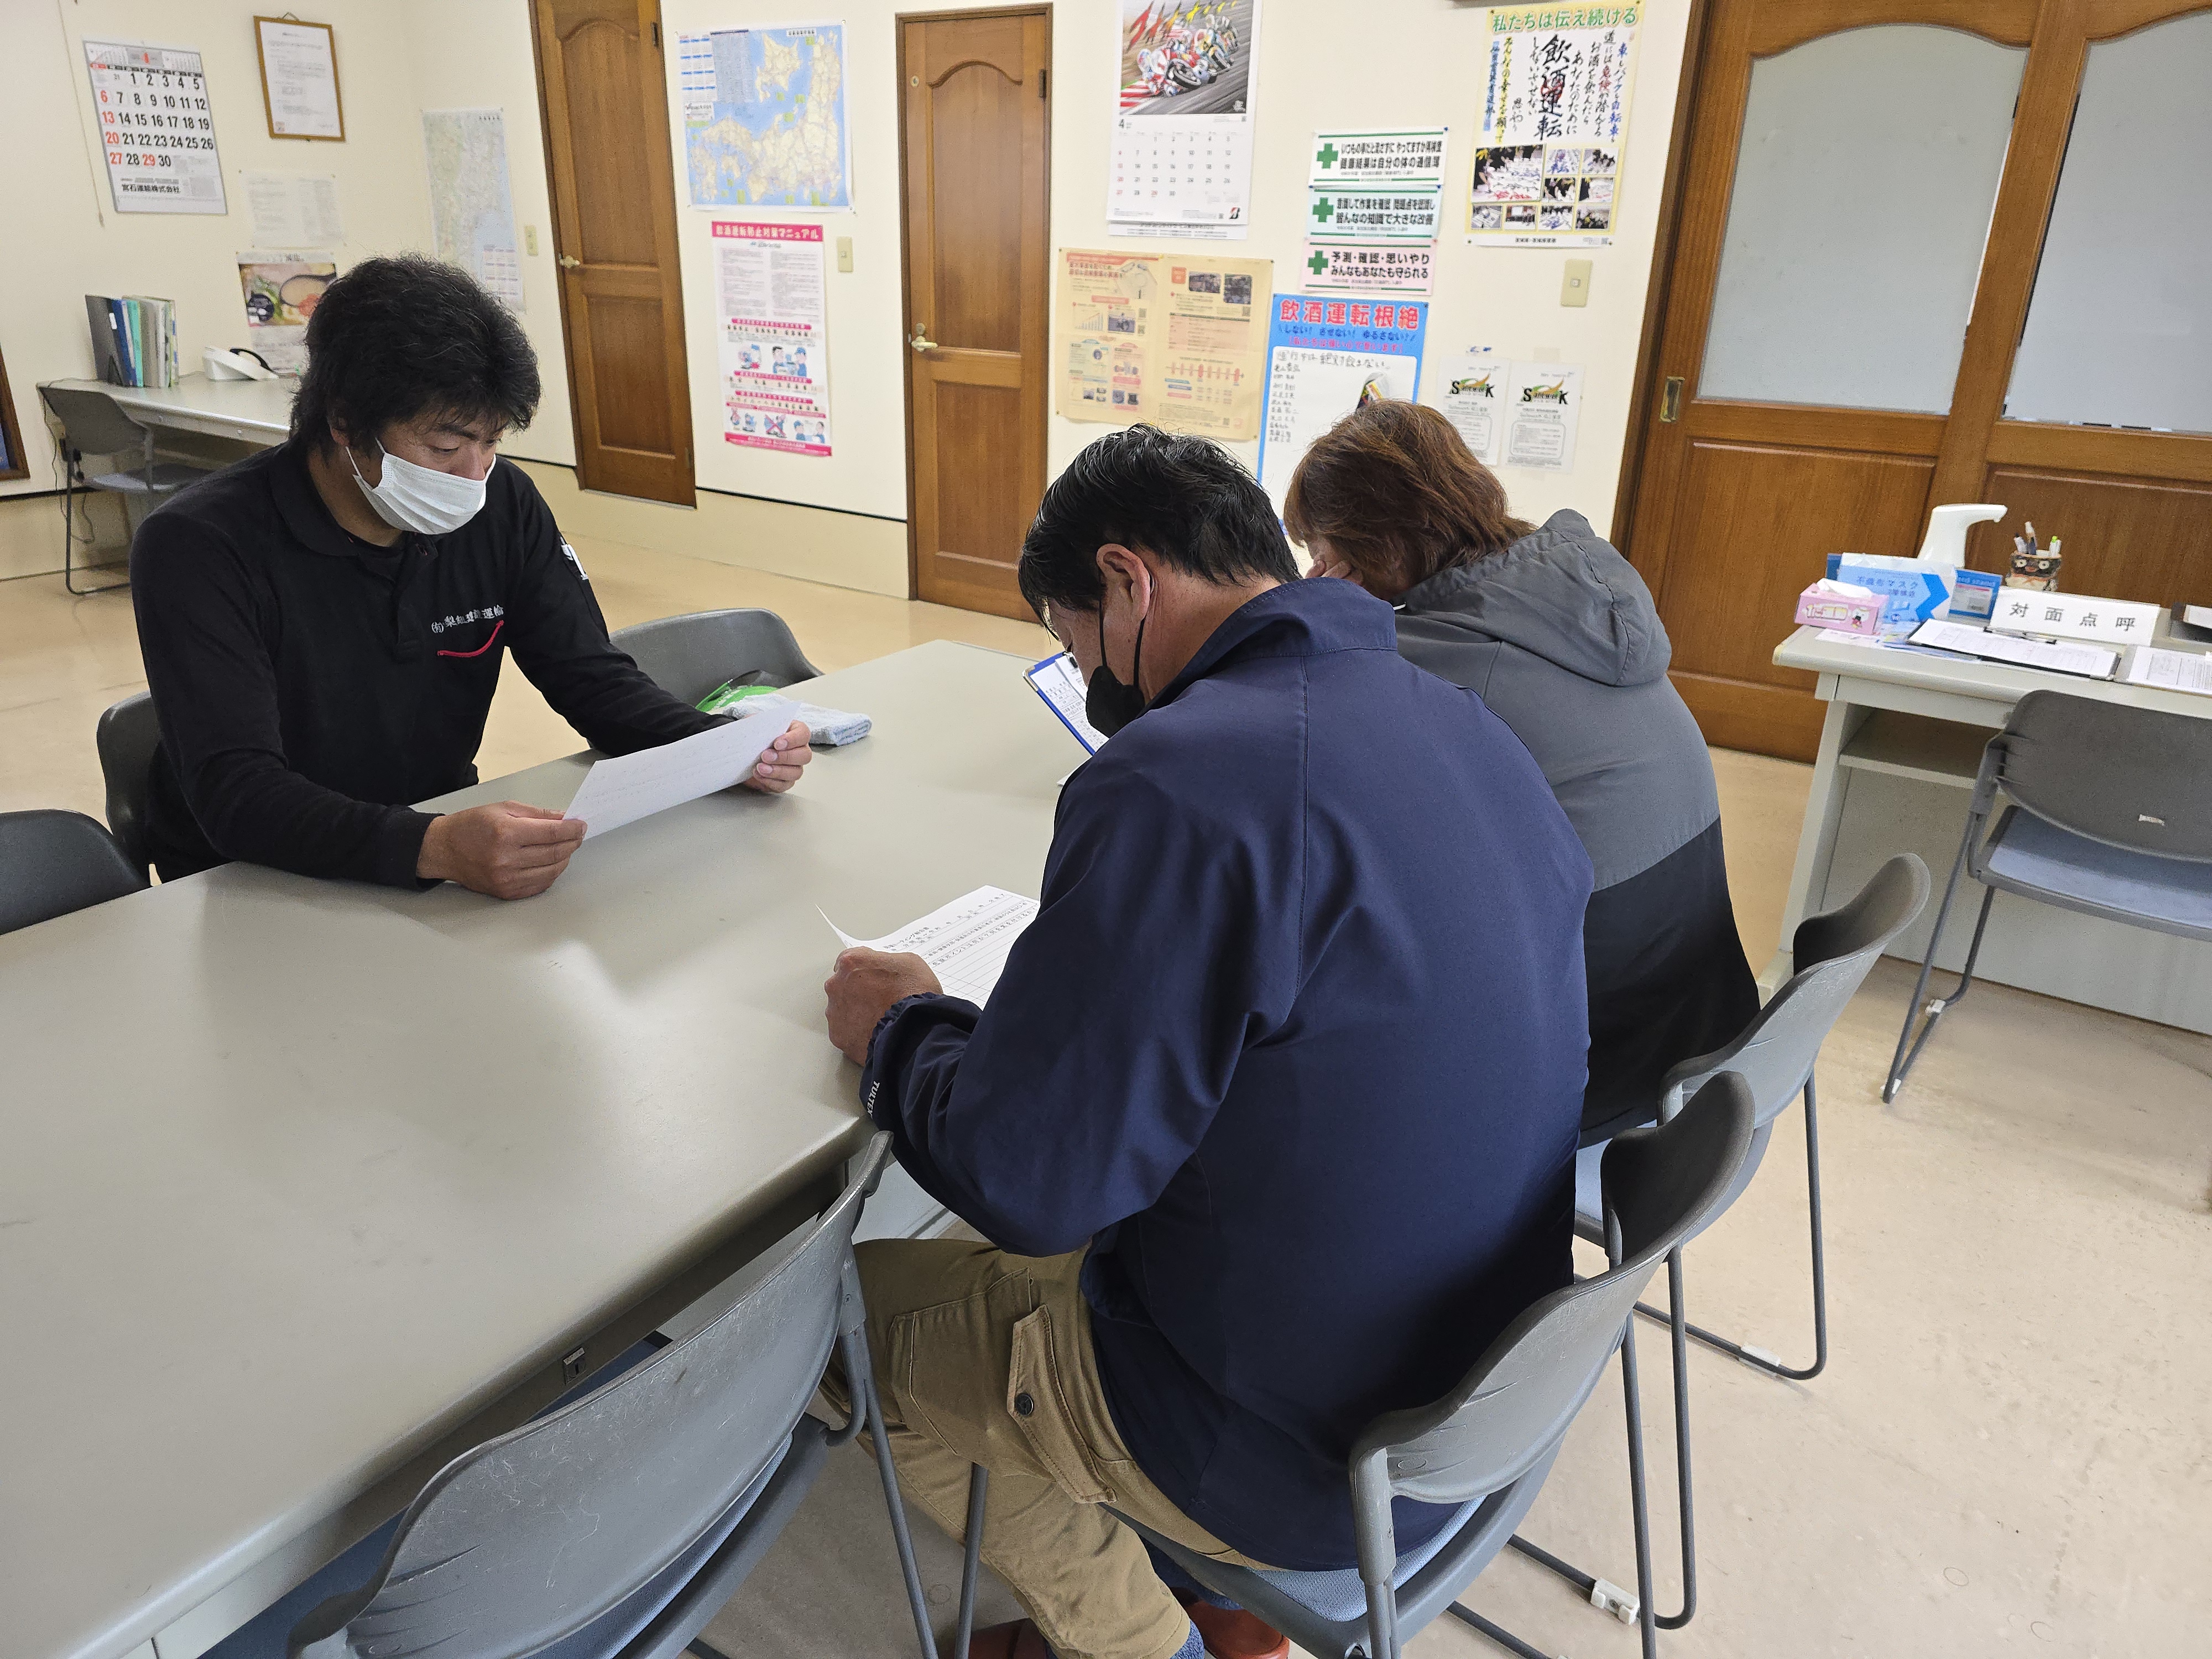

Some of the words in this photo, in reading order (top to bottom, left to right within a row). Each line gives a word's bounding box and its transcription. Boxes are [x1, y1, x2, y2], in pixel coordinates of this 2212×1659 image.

[1493, 7, 1636, 33] 私たちは伝え続ける
[131, 72, 137, 85] 1
[146, 74, 154, 86] 2
[163, 75, 169, 87] 3
[178, 77, 184, 88] 4
[194, 77, 200, 90] 5
[1533, 33, 1572, 140] 飲酒運転
[100, 90, 108, 102] 6
[116, 92, 123, 103] 7
[134, 93, 141, 105] 8
[150, 94, 157, 106] 9
[163, 95, 175, 108] 10
[180, 97, 190, 109] 11
[195, 98, 206, 110] 12
[102, 111, 115, 124] 13
[118, 112, 131, 124] 14
[135, 113, 147, 126] 15
[151, 114, 163, 127] 16
[167, 116, 178, 128] 17
[182, 117, 194, 129] 18
[198, 118, 210, 130] 19
[1118, 119, 1125, 129] 4
[105, 131, 119, 144] 20
[122, 132, 134, 145] 21
[138, 134, 152, 146] 22
[154, 134, 167, 147] 23
[170, 135, 183, 148] 24
[185, 137, 198, 149] 25
[201, 138, 213, 150] 26
[109, 152, 122, 165] 27
[126, 153, 139, 165] 28
[142, 154, 156, 166] 29
[158, 155, 171, 167] 30
[1331, 265, 1428, 279] みんなもあなたも守られる
[1280, 299, 1419, 330] 飲酒運転根絶
[2010, 602, 2136, 632] 対面点呼
[867, 1081, 880, 1117] TULTEX
